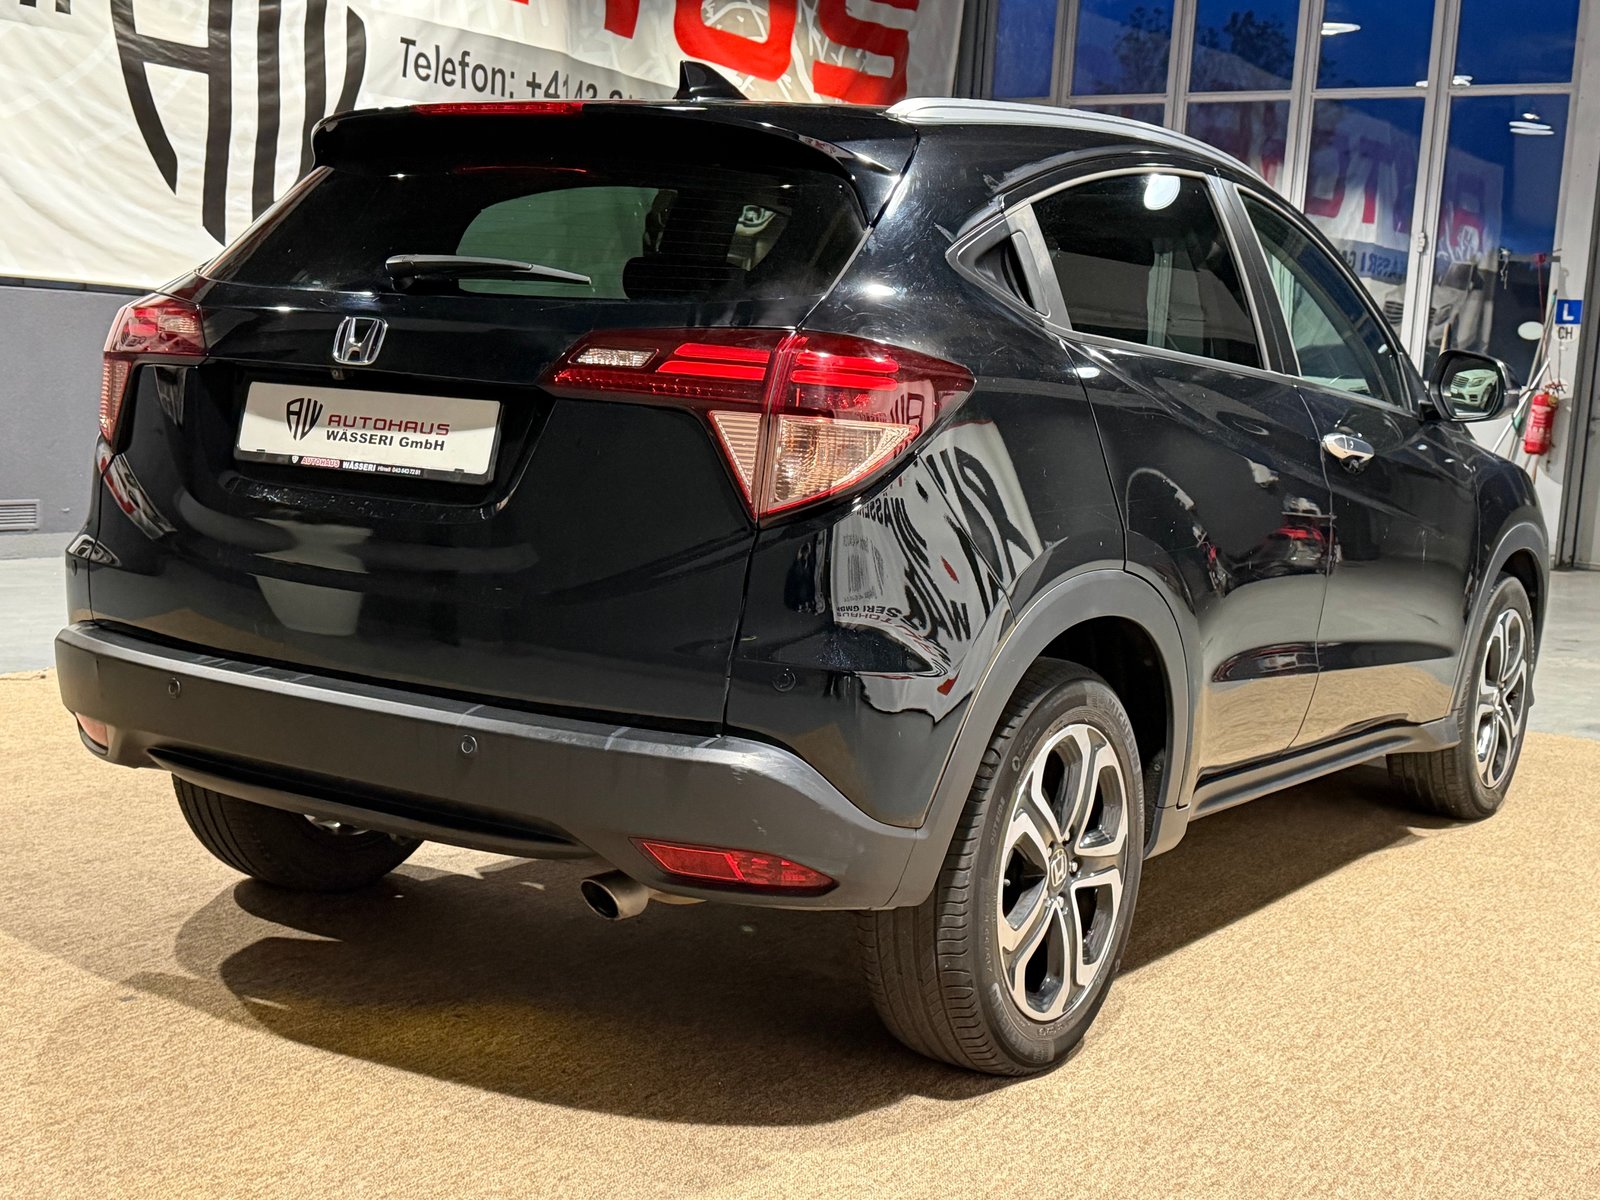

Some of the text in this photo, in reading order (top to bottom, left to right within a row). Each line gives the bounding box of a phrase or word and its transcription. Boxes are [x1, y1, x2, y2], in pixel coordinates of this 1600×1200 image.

[400, 36, 515, 99] Telefon:
[1562, 303, 1575, 321] L
[1558, 326, 1574, 340] CH
[327, 414, 450, 436] AUTOHAUS
[326, 429, 445, 451] WÄSSERI GmbH
[300, 455, 340, 468] AUTOHAUS
